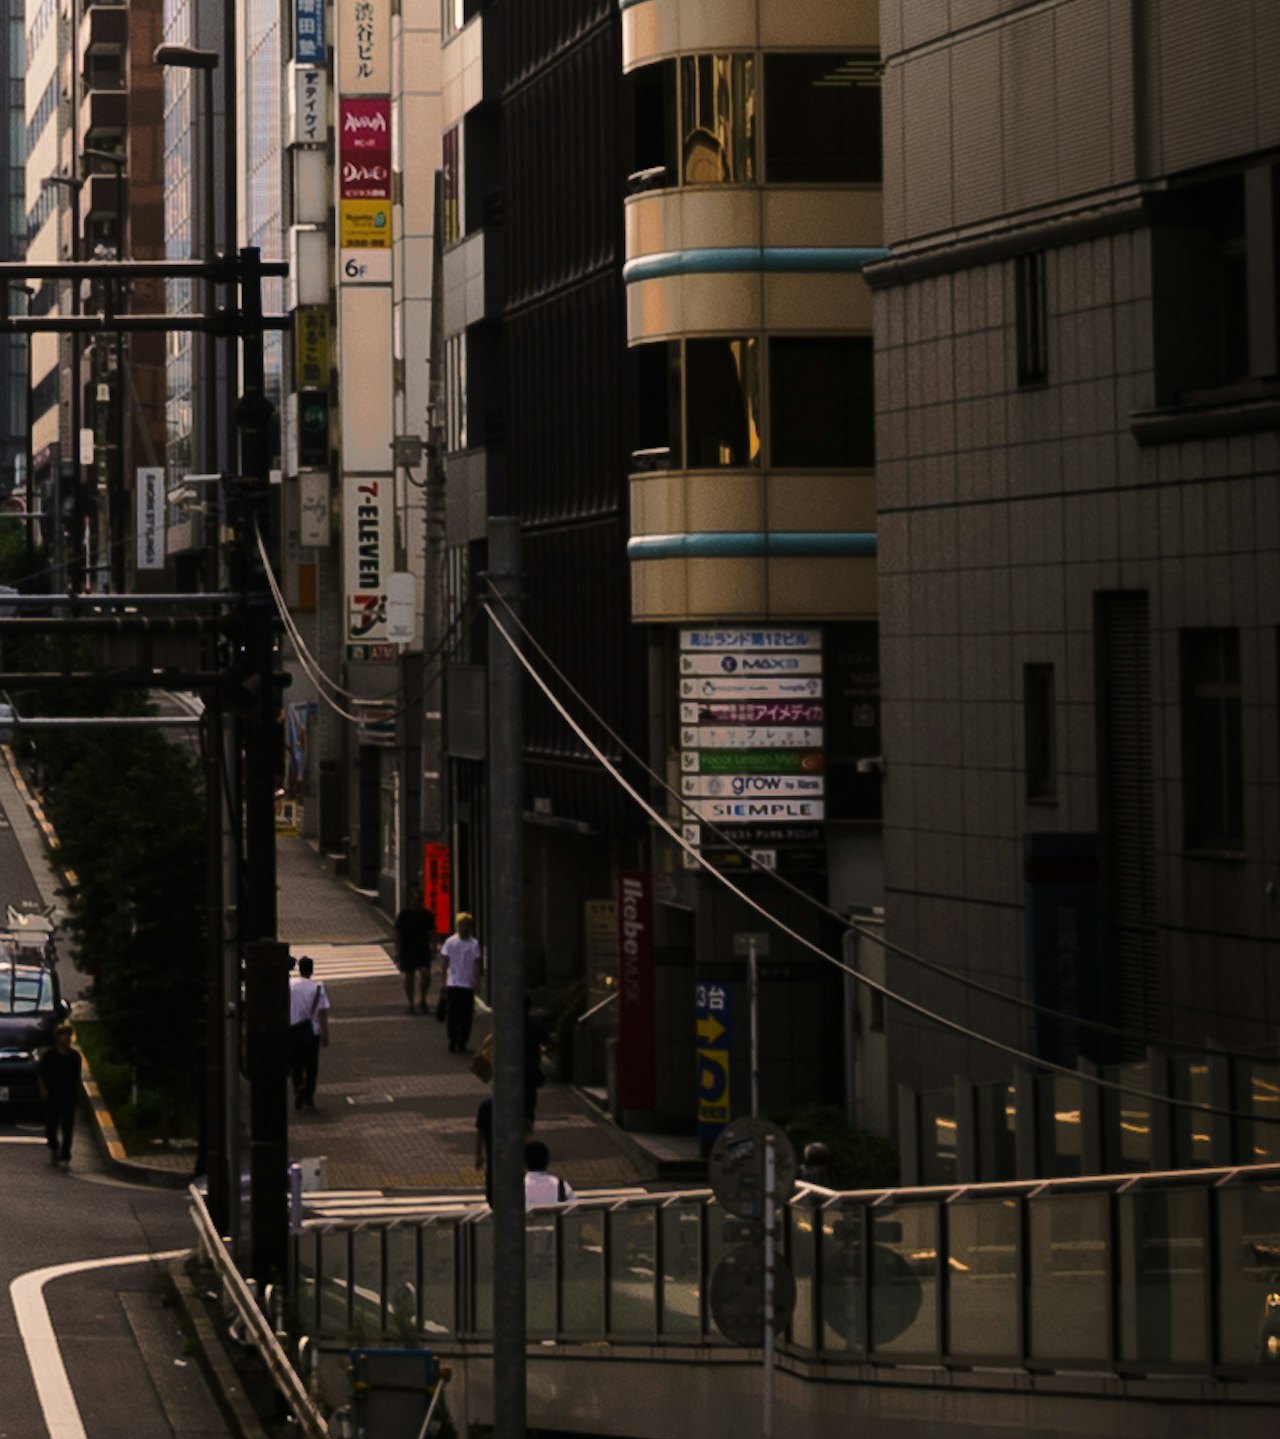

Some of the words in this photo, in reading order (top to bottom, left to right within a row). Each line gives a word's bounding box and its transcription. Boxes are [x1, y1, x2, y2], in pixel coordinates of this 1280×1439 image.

[344, 258, 367, 277] 6F
[732, 777, 782, 795] grow
[713, 804, 812, 816] SIEMPLE
[622, 877, 645, 956] Ikebe
